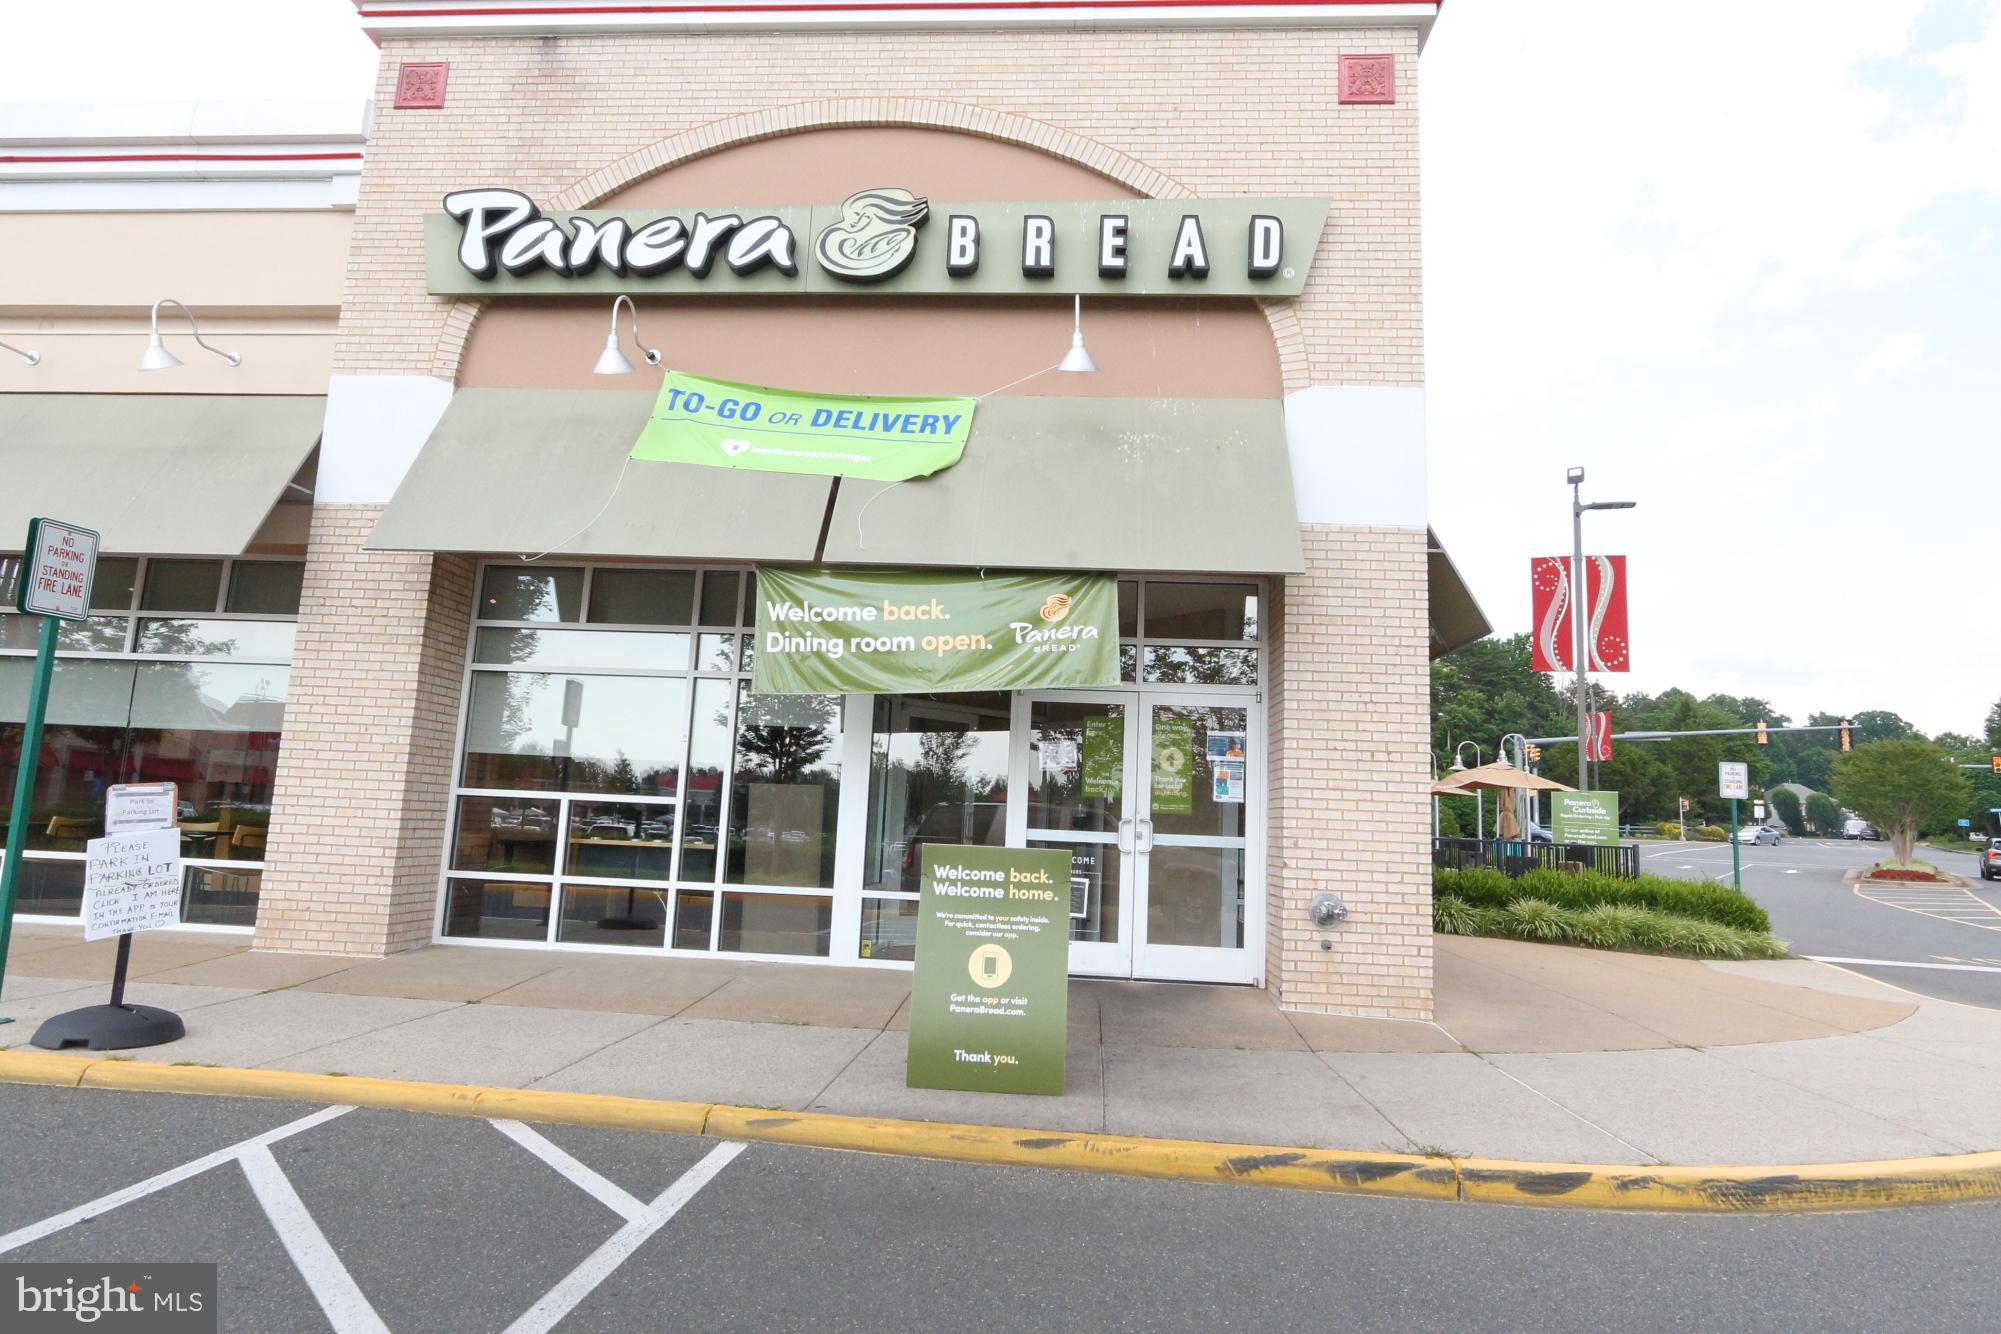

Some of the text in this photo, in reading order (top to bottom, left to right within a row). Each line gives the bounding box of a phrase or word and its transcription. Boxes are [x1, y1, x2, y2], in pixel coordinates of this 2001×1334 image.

[444, 189, 1284, 279] Panera BREAD
[667, 388, 962, 435] TO-GO OR DELIVERY
[62, 536, 74, 547] NO
[48, 545, 84, 563] PARKING
[42, 565, 84, 583] STANDING
[38, 577, 83, 598] FIRE LANE
[767, 598, 950, 622] Welcome back.
[1009, 622, 1099, 644] Panera
[766, 632, 993, 658] Dining room open.
[1564, 798, 1591, 807] Panera
[1573, 806, 1607, 815] Curbside
[101, 842, 149, 854] PLEASE
[88, 854, 149, 870] PARK IN
[89, 862, 173, 884] PARKING LOT
[934, 864, 1053, 884] Welcome back.
[96, 879, 178, 898] ALREADY ORDERED
[932, 881, 1004, 898] Welcome
[1009, 884, 1059, 901] home.
[93, 899, 120, 910] CLICK
[144, 891, 157, 899] AM
[161, 887, 180, 896] HERE
[109, 908, 122, 917] THE
[127, 903, 145, 914] APP
[160, 900, 177, 909] YOUR
[936, 911, 953, 919] We're
[1010, 915, 1029, 923] safety
[955, 920, 974, 929] quick,
[975, 922, 1011, 930] contactless
[1004, 932, 1019, 940] app.
[950, 994, 1028, 1006] Get the app or visit
[950, 1004, 1026, 1016] PaneraBread.com.
[954, 1050, 1019, 1066] Thank you.
